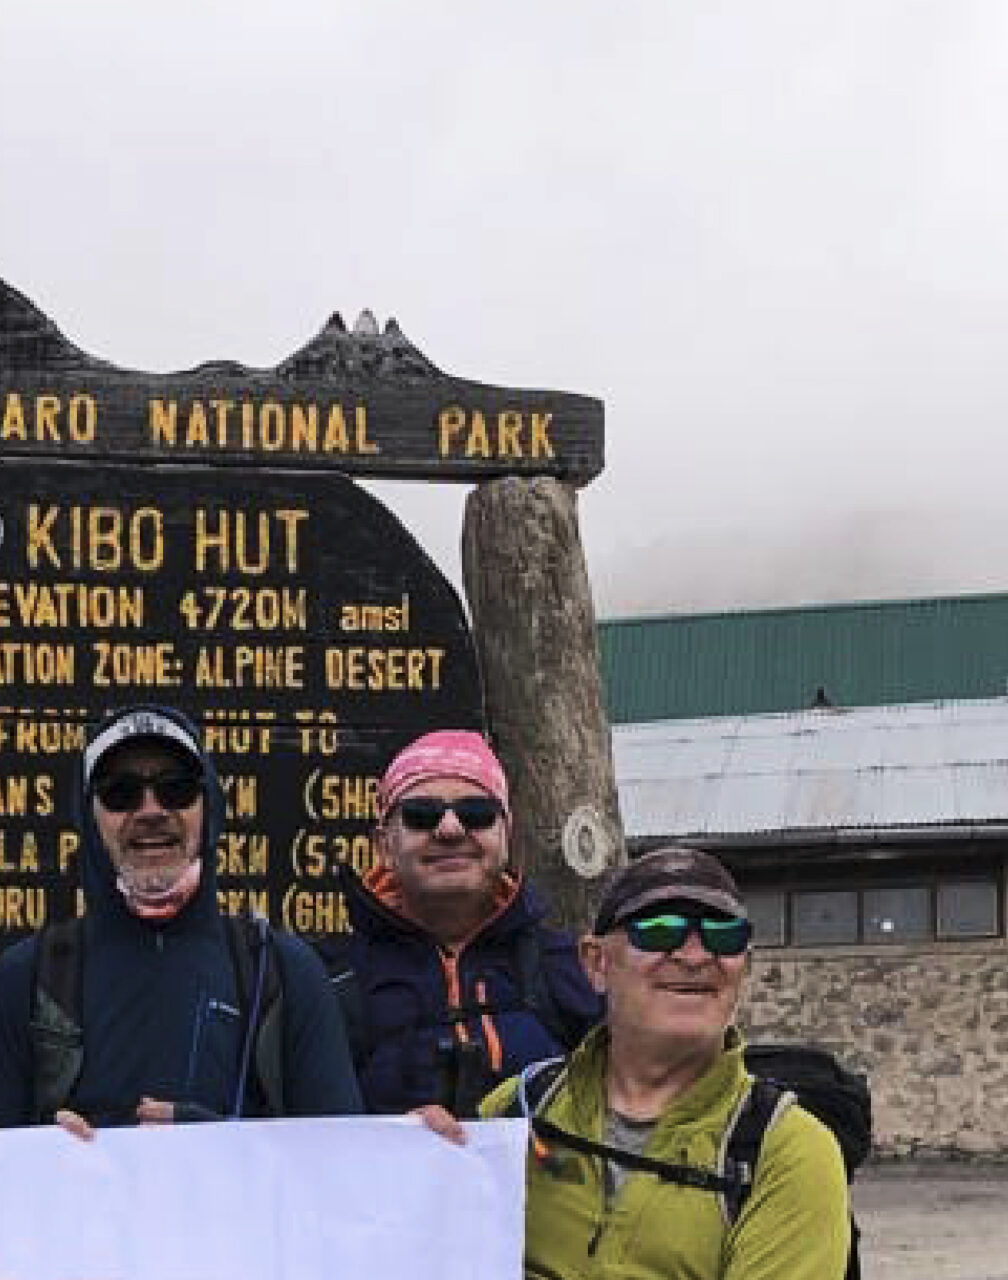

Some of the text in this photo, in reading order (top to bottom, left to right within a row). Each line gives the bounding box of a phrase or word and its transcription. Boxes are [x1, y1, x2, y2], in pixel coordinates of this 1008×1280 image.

[149, 400, 380, 454] NATIONAL
[438, 406, 555, 459] PARK
[27, 505, 309, 574] KIBO HUT
[180, 587, 307, 631] 4720M
[340, 594, 409, 634] amsl
[92, 642, 182, 687] ZONE:
[196, 645, 304, 689] ALPINE
[325, 647, 446, 691] DESERT
[203, 709, 276, 753] HUT
[296, 709, 337, 753] TO
